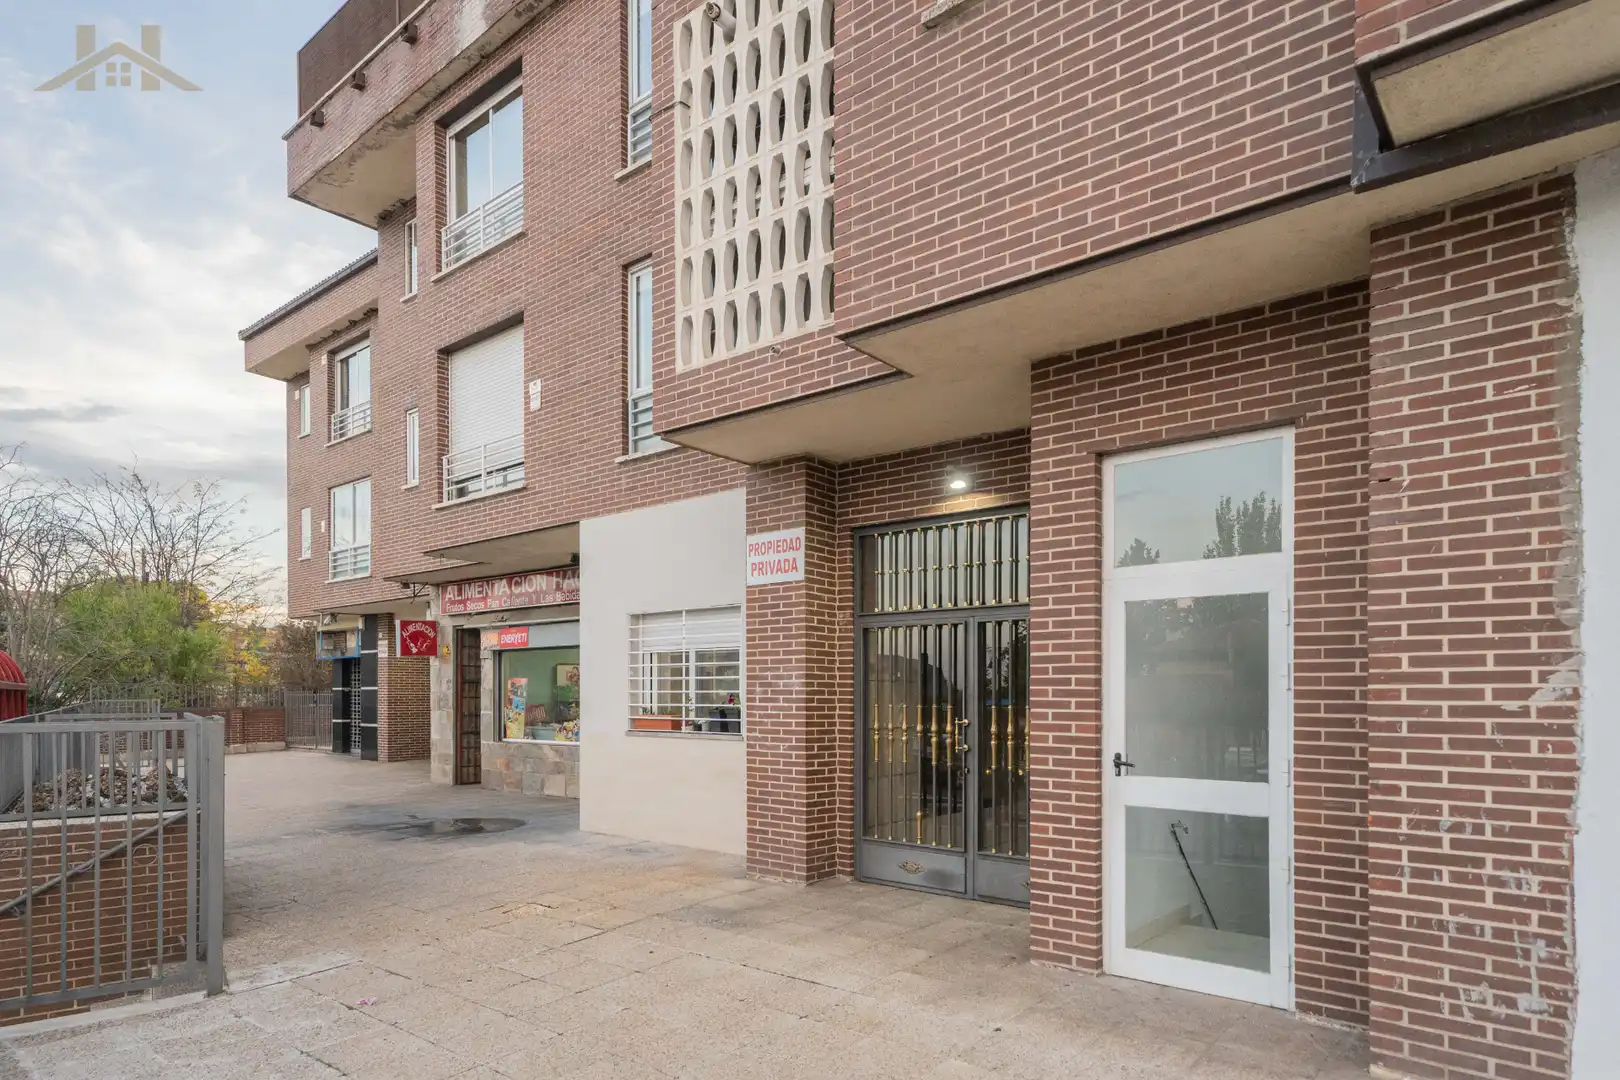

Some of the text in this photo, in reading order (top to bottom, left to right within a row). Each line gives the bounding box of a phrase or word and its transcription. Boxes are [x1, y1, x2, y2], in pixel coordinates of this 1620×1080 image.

[748, 536, 801, 557] PROPIEDAD
[751, 557, 798, 577] PRIVADA
[446, 602, 465, 613] Frutos
[466, 600, 485, 611] Secos
[487, 598, 500, 609] Pan
[501, 596, 529, 607] Caliente
[540, 592, 554, 603] Las
[402, 622, 436, 638] ALIMENTACION
